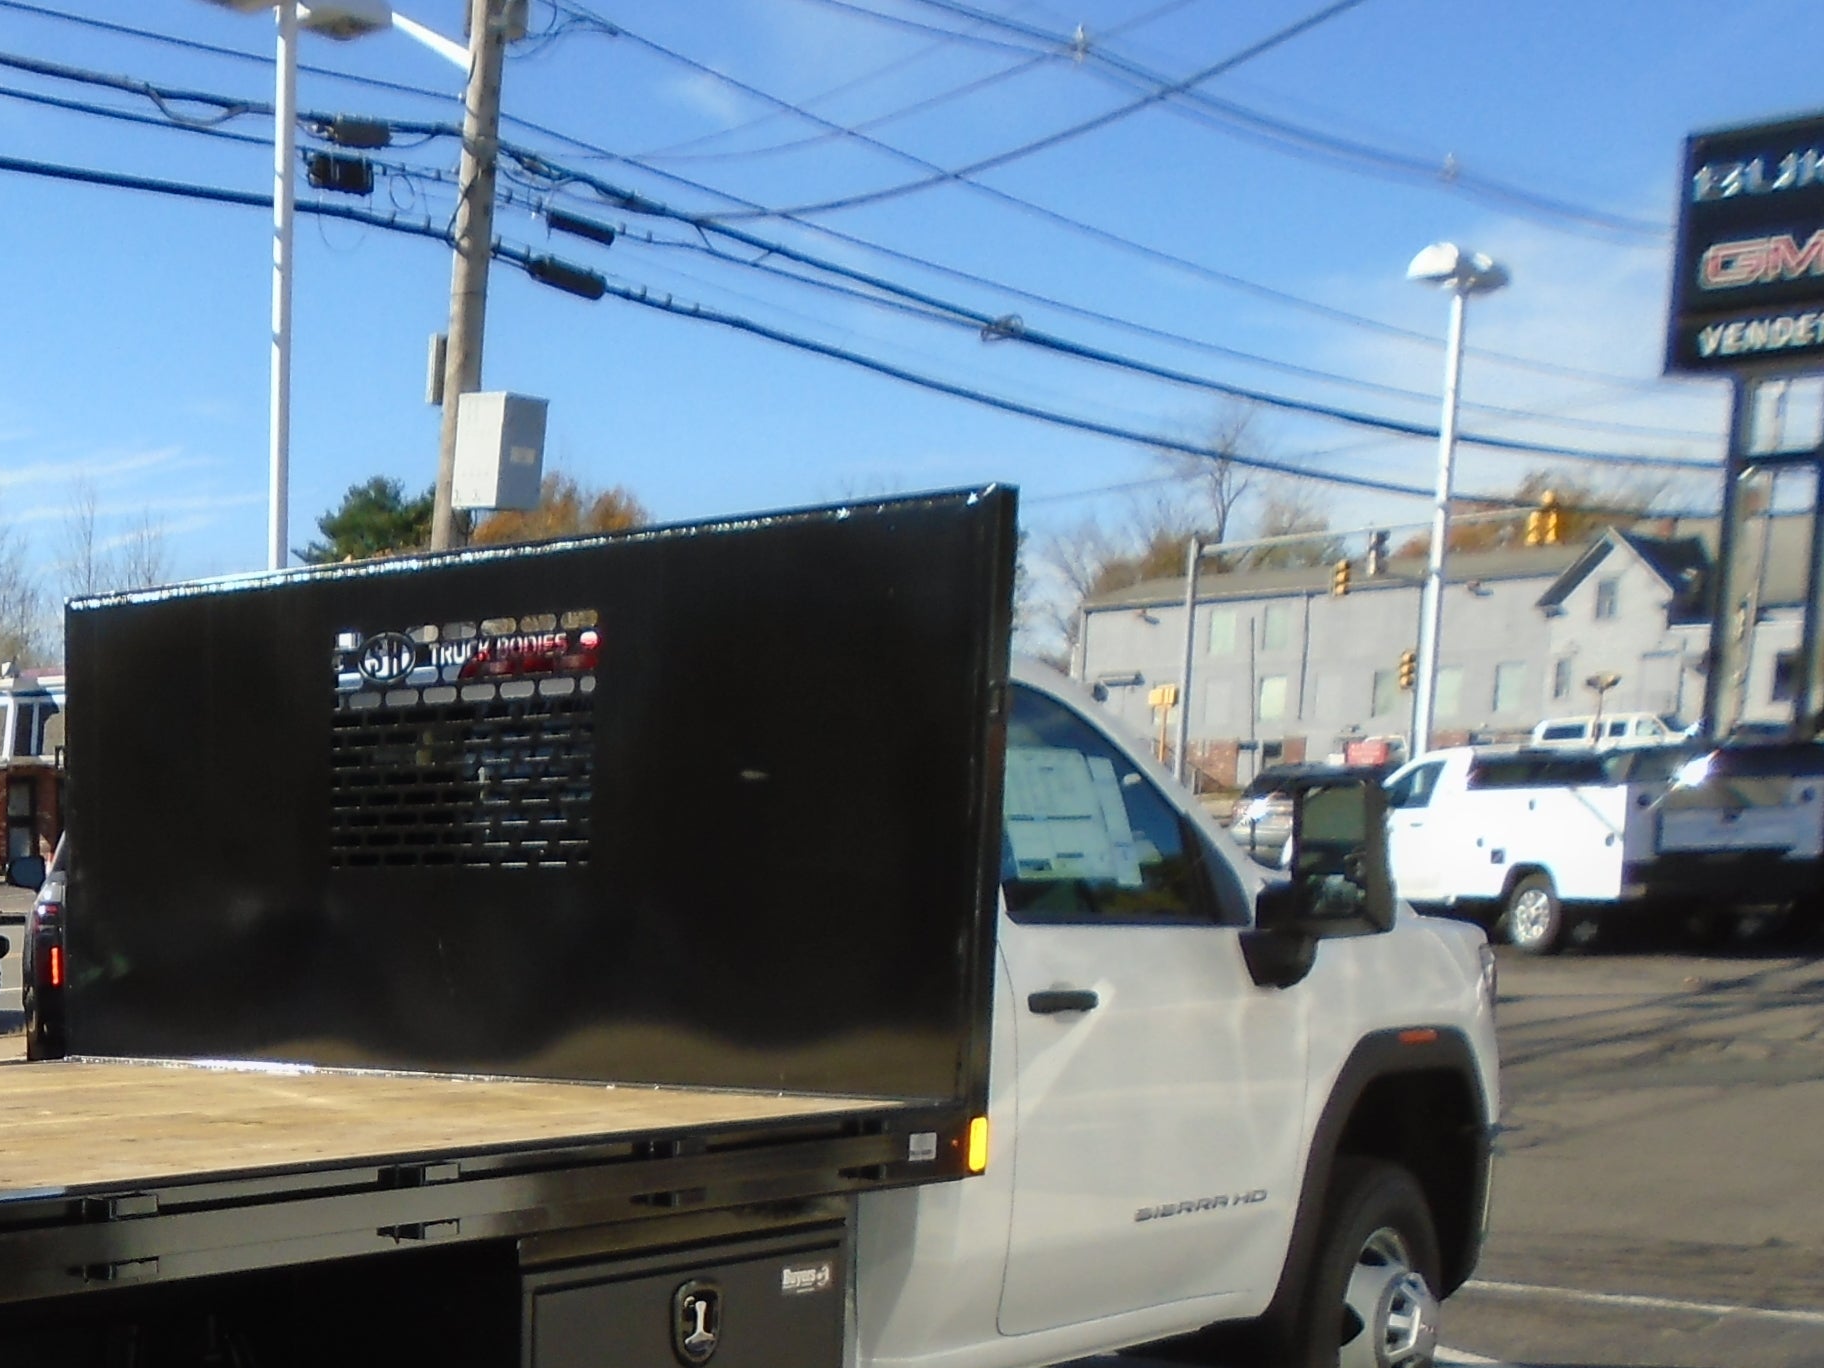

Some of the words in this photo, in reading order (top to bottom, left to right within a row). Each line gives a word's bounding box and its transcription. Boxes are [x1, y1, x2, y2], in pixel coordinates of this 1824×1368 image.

[1698, 312, 1824, 358] VENDE
[429, 642, 491, 666] TRUCK
[1134, 1195, 1229, 1222] SIERRA
[1231, 1189, 1268, 1206] HD
